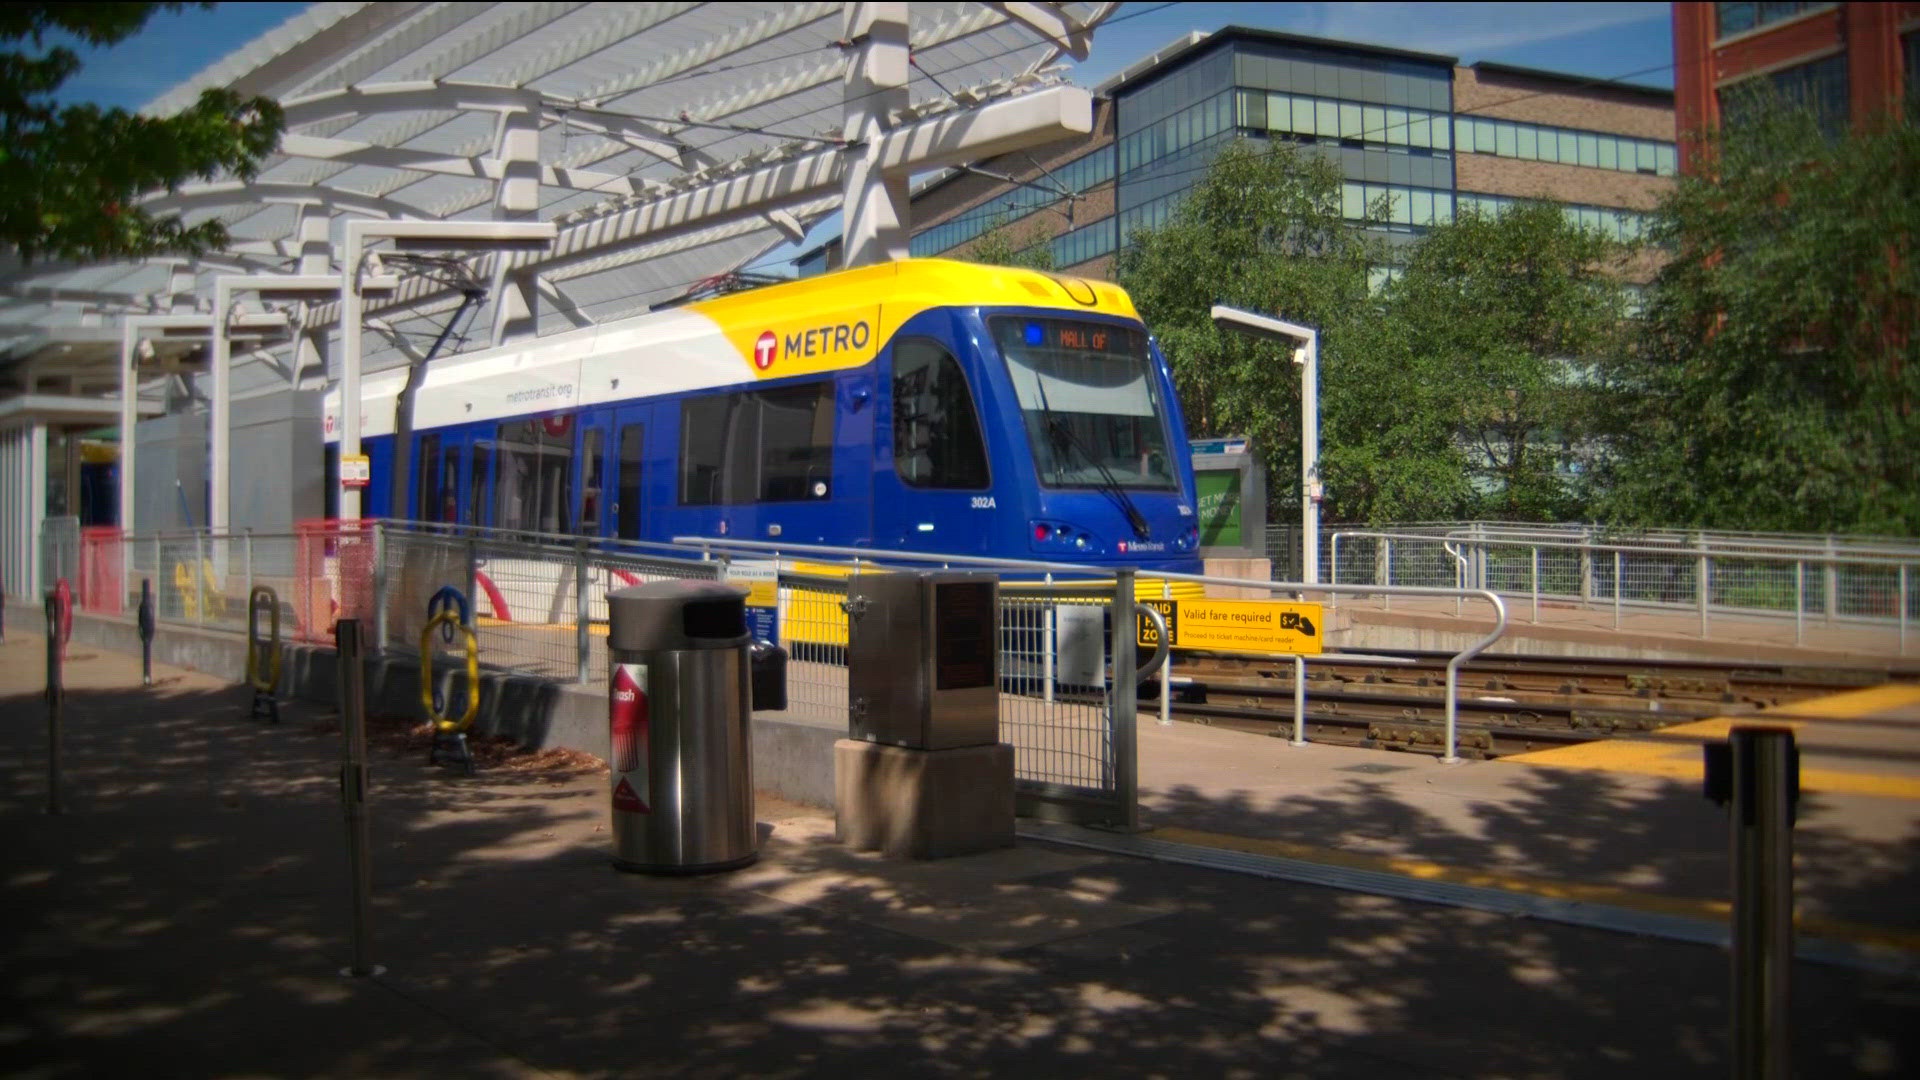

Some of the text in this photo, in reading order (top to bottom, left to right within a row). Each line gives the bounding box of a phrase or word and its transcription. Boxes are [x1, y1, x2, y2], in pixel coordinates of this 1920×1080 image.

[784, 321, 870, 360] METRO
[1060, 329, 1107, 349] MALL OF
[507, 383, 572, 403] metrotransit.org
[971, 496, 996, 509] 302A
[1198, 494, 1212, 507] ET
[1145, 615, 1172, 628] FE
[1183, 608, 1272, 624] Valid fare required
[1143, 629, 1174, 642] ZOE
[1183, 631, 1208, 639] Proceed
[1233, 634, 1274, 642] machine/card
